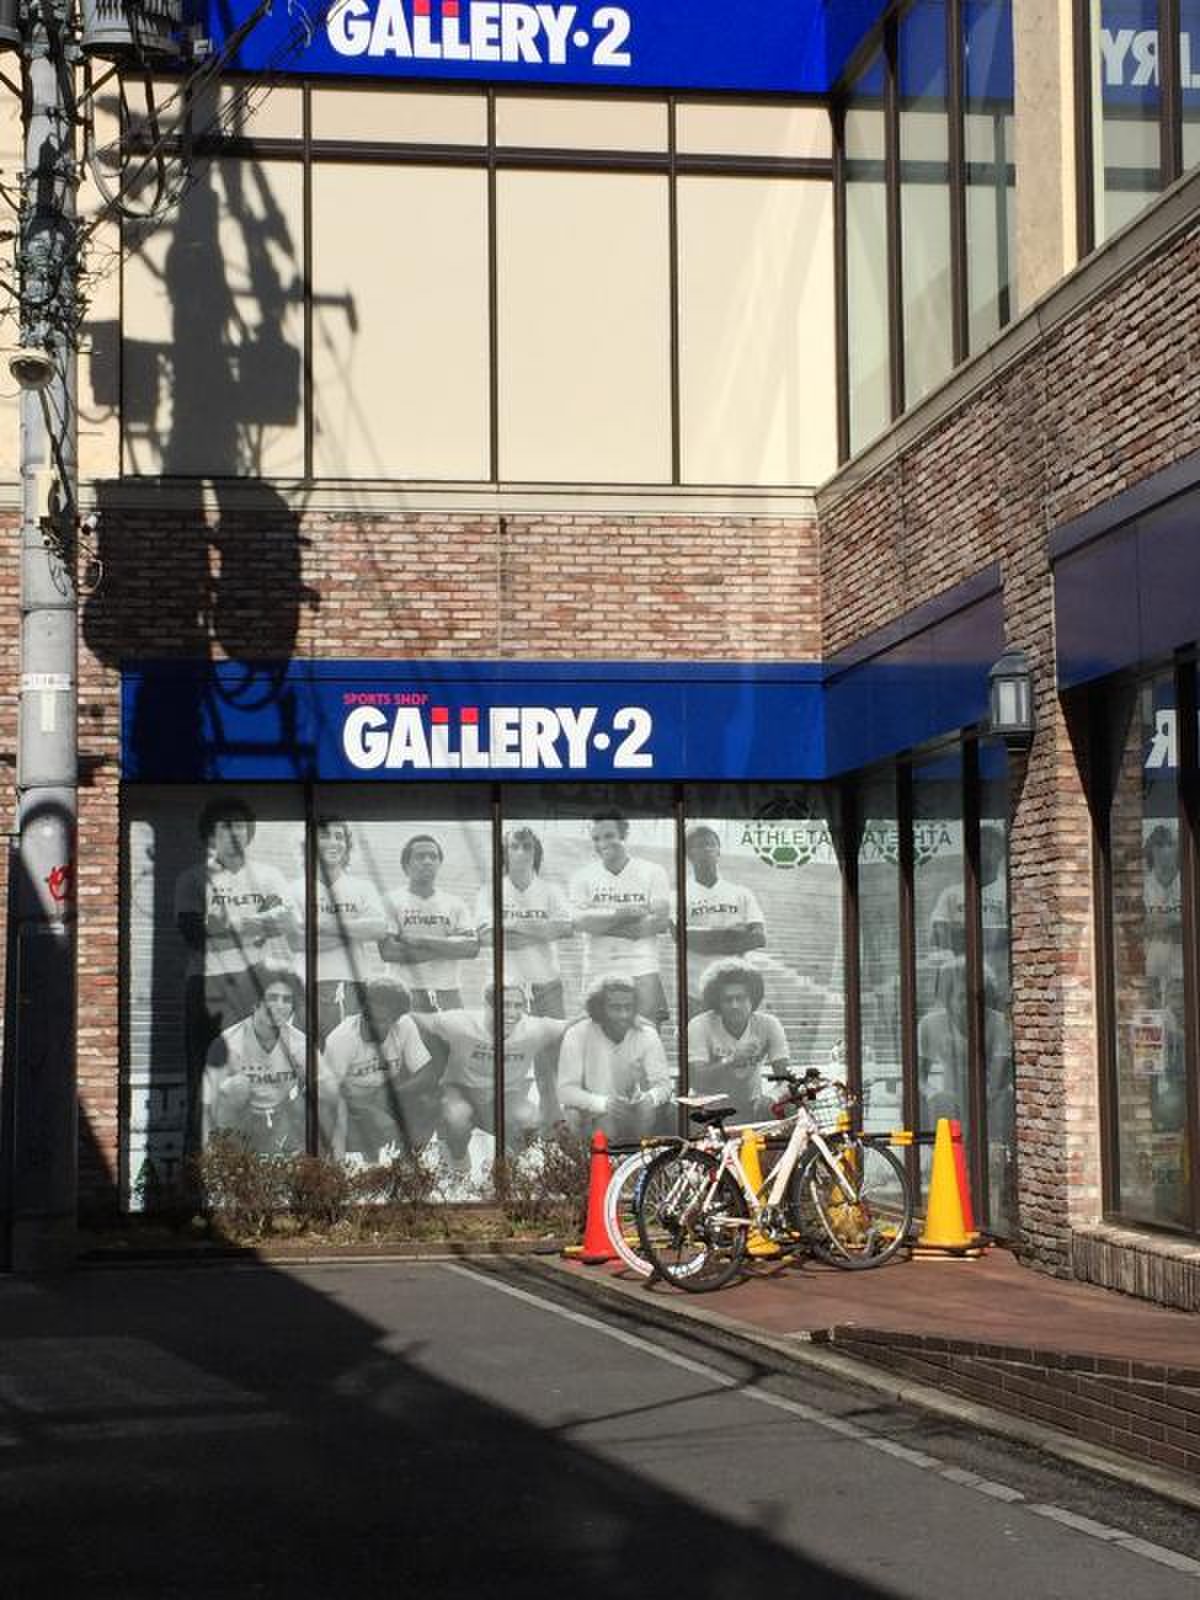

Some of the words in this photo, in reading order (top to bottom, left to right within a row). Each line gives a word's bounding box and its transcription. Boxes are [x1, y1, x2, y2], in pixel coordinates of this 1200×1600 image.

[343, 692, 391, 704] SPORTS
[394, 692, 429, 704] SHOP
[740, 830, 832, 846] ATHLETA
[592, 892, 647, 903] ATHLETA
